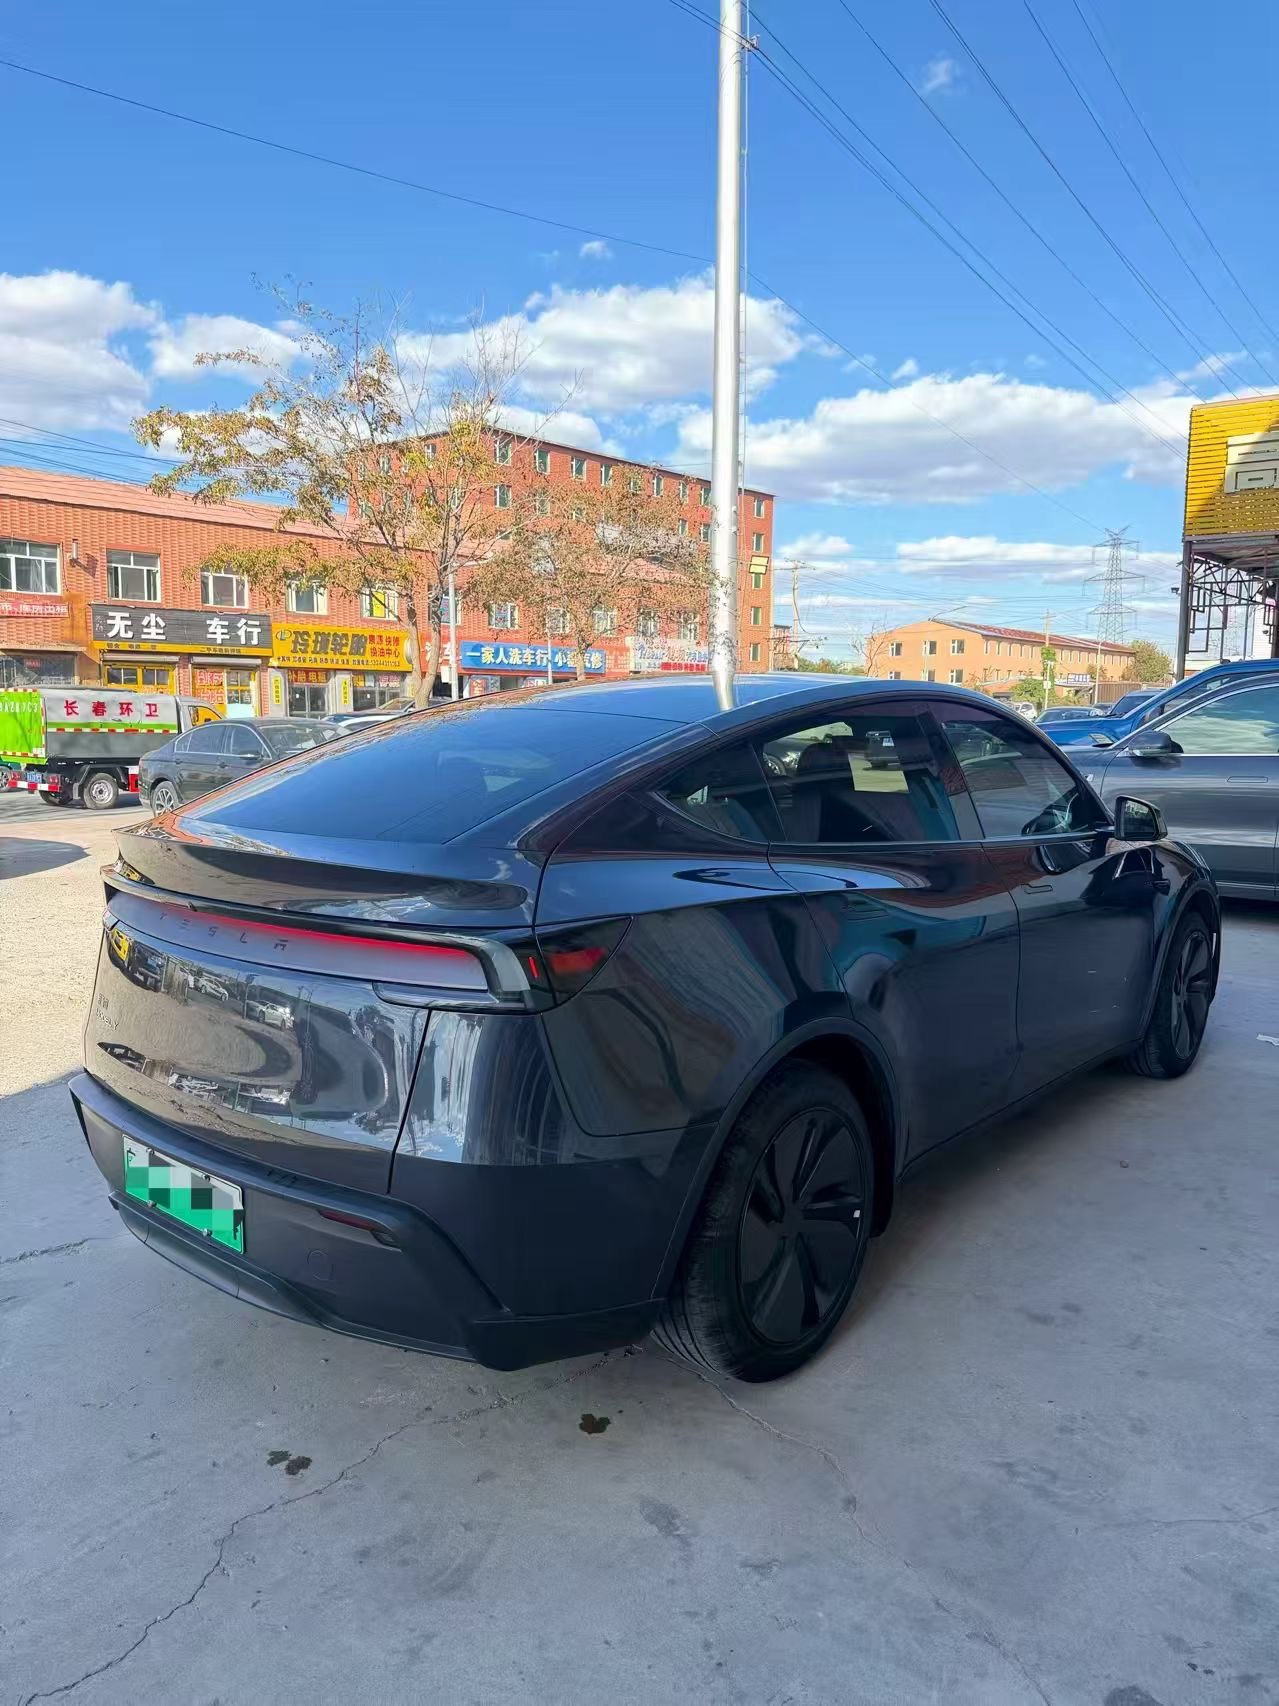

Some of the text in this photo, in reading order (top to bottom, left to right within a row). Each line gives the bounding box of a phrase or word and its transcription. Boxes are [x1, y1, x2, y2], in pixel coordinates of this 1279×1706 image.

[107, 611, 167, 640] 无尘
[206, 617, 262, 646] 车行
[466, 646, 549, 666] 一家人洗车行
[64, 699, 159, 718] 长春环卫
[160, 911, 289, 952] TESLA
